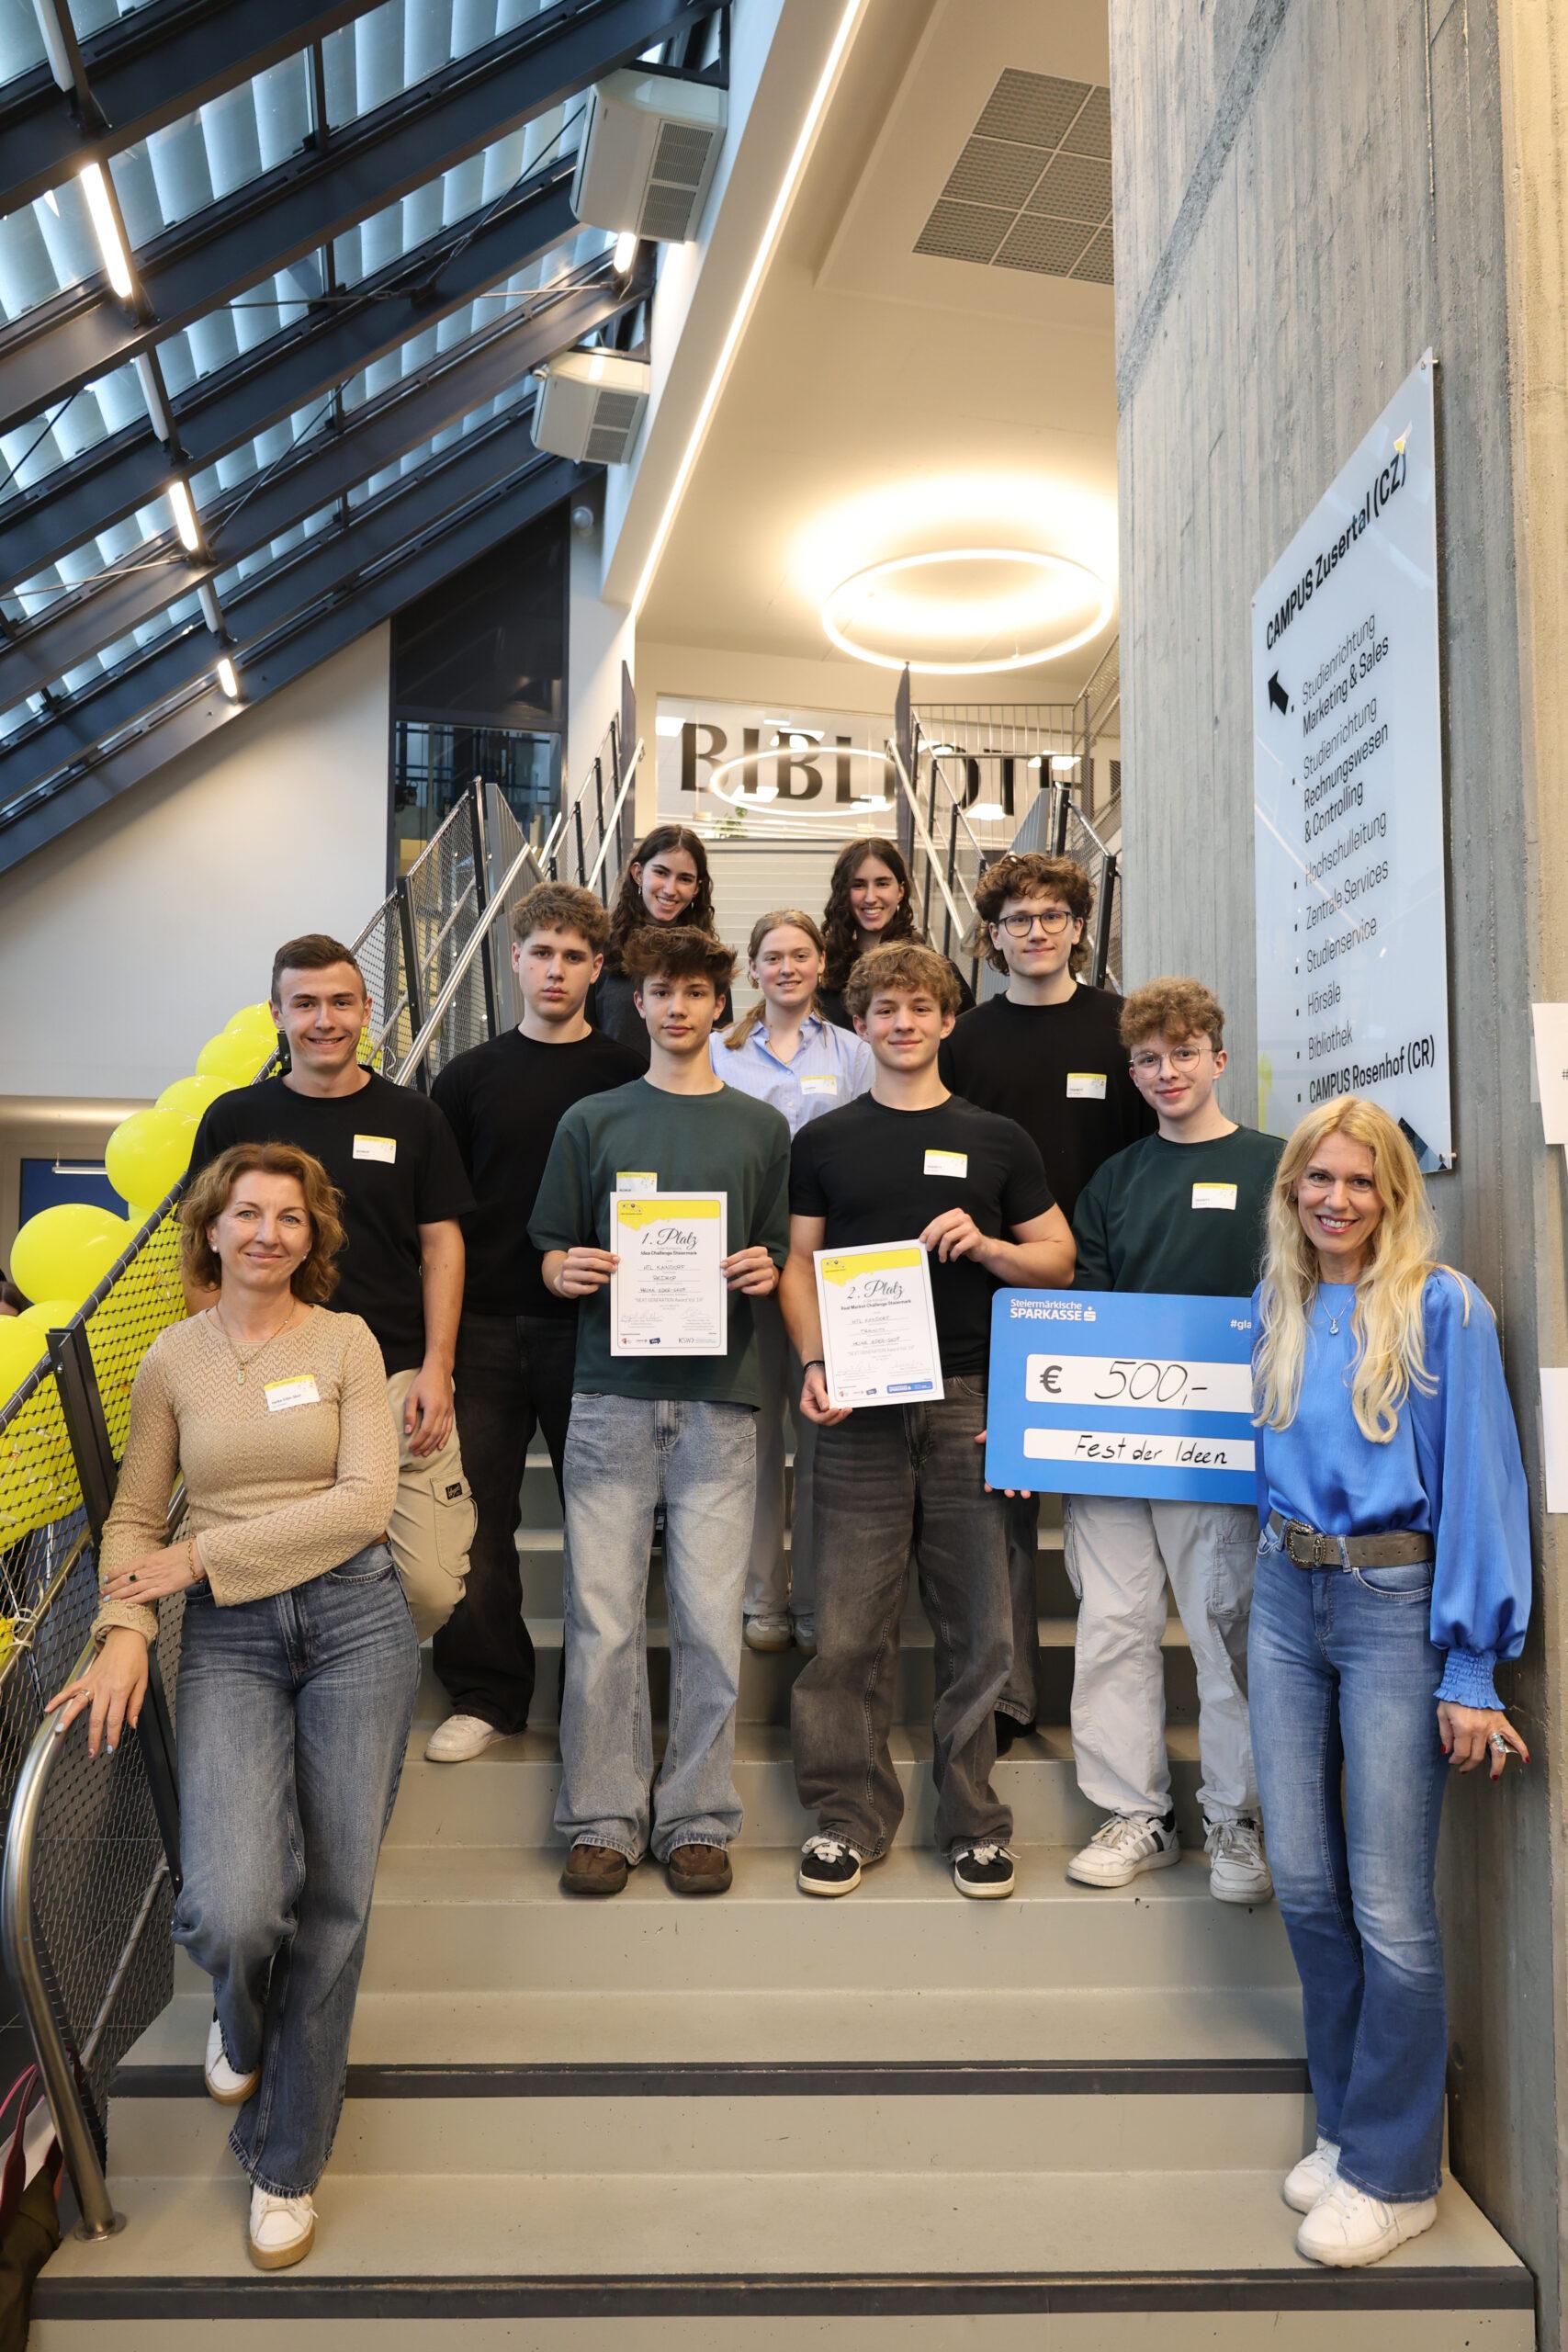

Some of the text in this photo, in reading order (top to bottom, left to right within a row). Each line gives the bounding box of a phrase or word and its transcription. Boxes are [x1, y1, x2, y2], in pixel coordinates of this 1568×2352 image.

[1266, 452, 1407, 650] CAMPUS Zusertal (CZ)
[1303, 614, 1375, 706] Studienrichtung
[1303, 636, 1389, 738] Marketing & Sales
[1303, 696, 1377, 780] Studienrichtung
[1304, 723, 1389, 812] Rechnungswesen
[1313, 781, 1364, 838] Controlling
[1305, 811, 1387, 887] Hochschulleitung
[1306, 860, 1389, 931] Zentrale Services
[1306, 917, 1377, 973] Studienservice
[1308, 981, 1341, 1017] Hörsäle
[1308, 1020, 1353, 1060] Bibliothek
[1309, 1035, 1435, 1103] CAMPUS Rosenhof (CR)
[657, 1227, 697, 1250] Platz
[863, 1279, 904, 1300] Platz
[1010, 1298, 1082, 1310] Steiermärkische
[1010, 1307, 1082, 1321] SPARKASSE
[1039, 1364, 1063, 1394] €
[1074, 1434, 1228, 1464] Fest der Ideen
